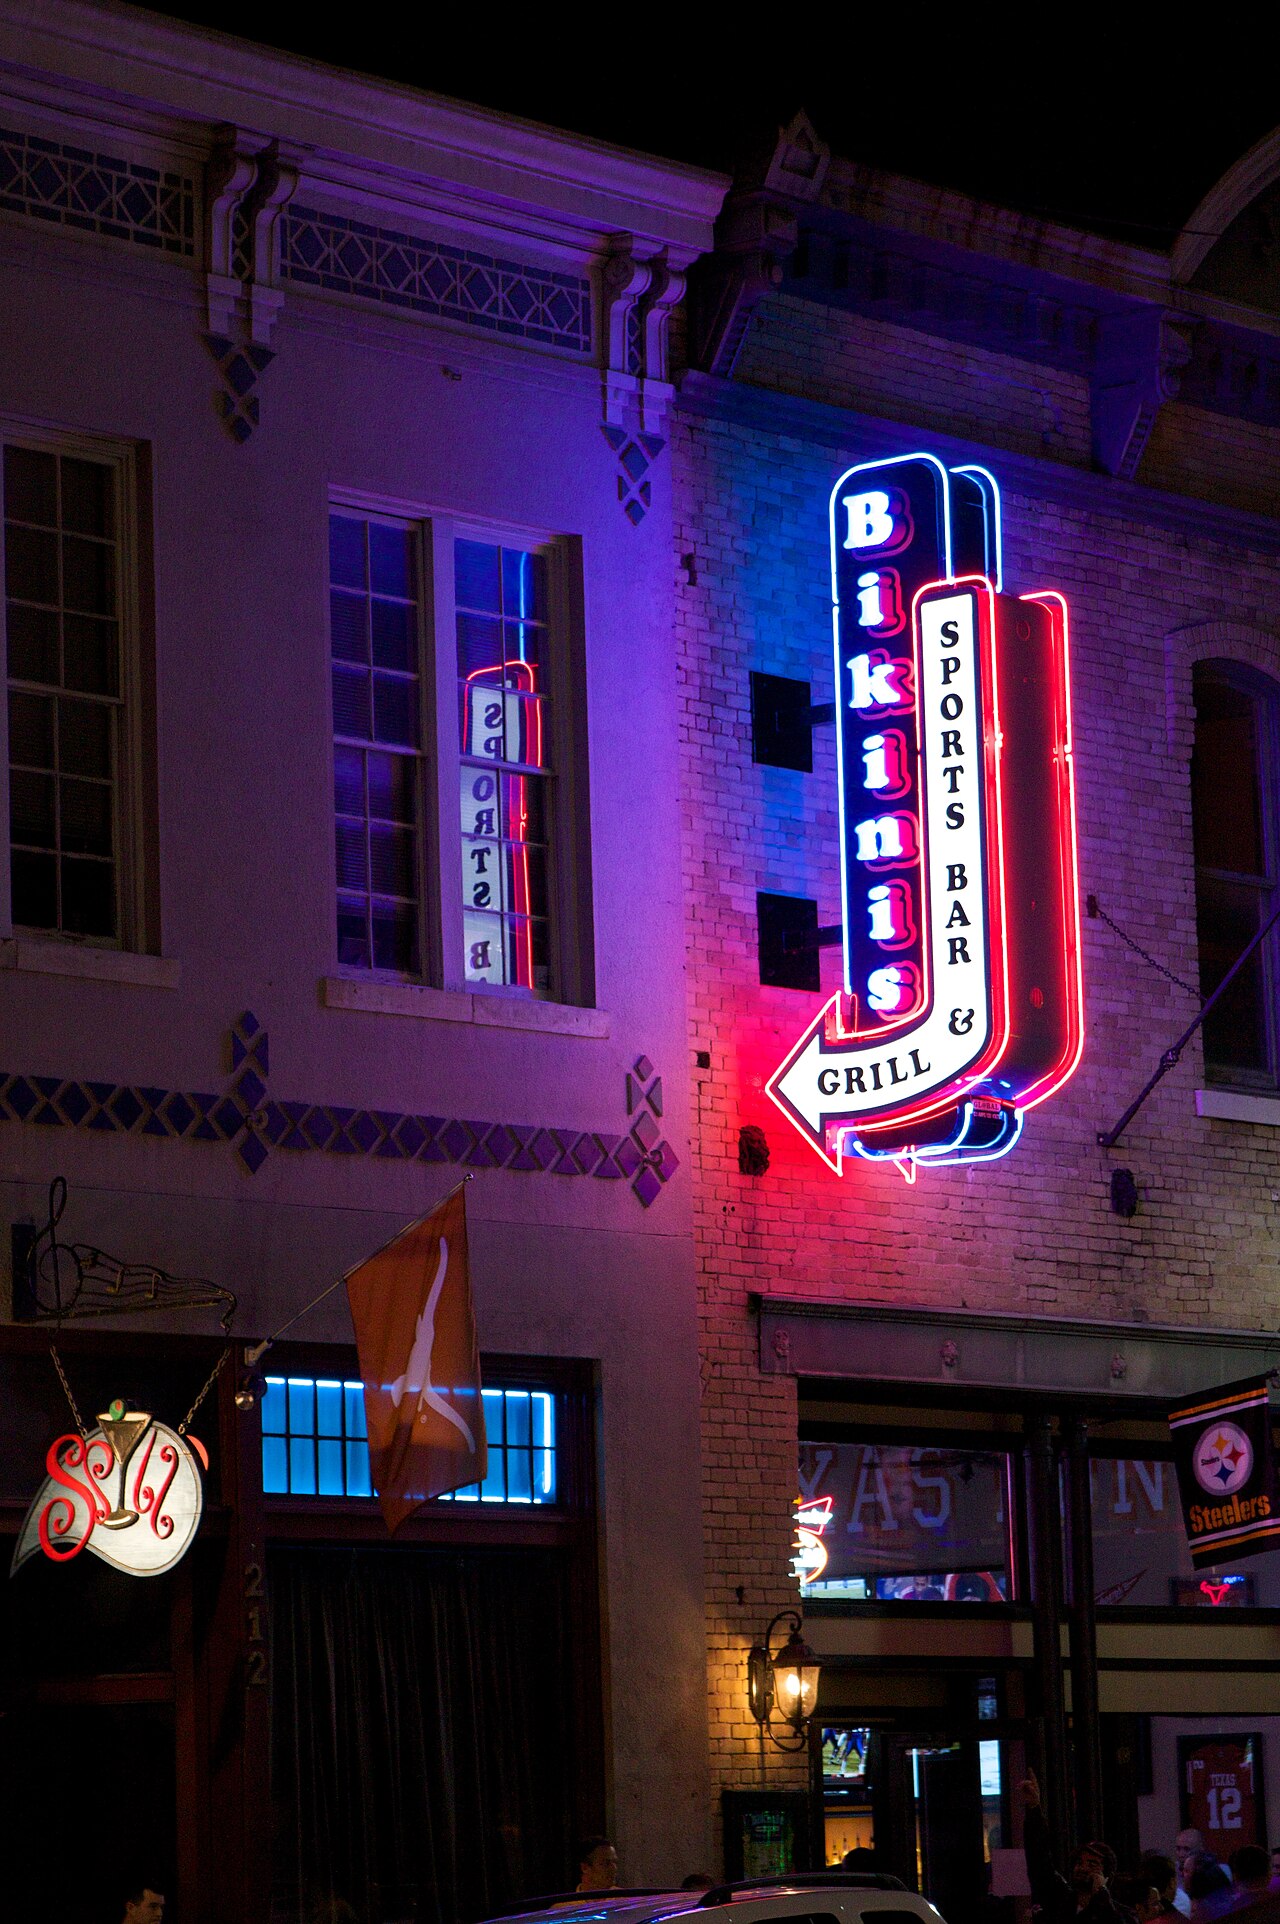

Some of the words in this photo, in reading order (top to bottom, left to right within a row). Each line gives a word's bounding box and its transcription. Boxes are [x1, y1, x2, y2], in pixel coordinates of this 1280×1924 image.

[940, 621, 965, 830] SPORTS
[842, 491, 907, 1012] Bikinis
[946, 864, 971, 964] BAR
[948, 1008, 974, 1036] &
[817, 1049, 931, 1095] GRILL
[1189, 1494, 1271, 1533] Steelers
[245, 1565, 267, 1686] 212
[1209, 1773, 1237, 1787] TEXAS
[1207, 1787, 1243, 1830] 12
